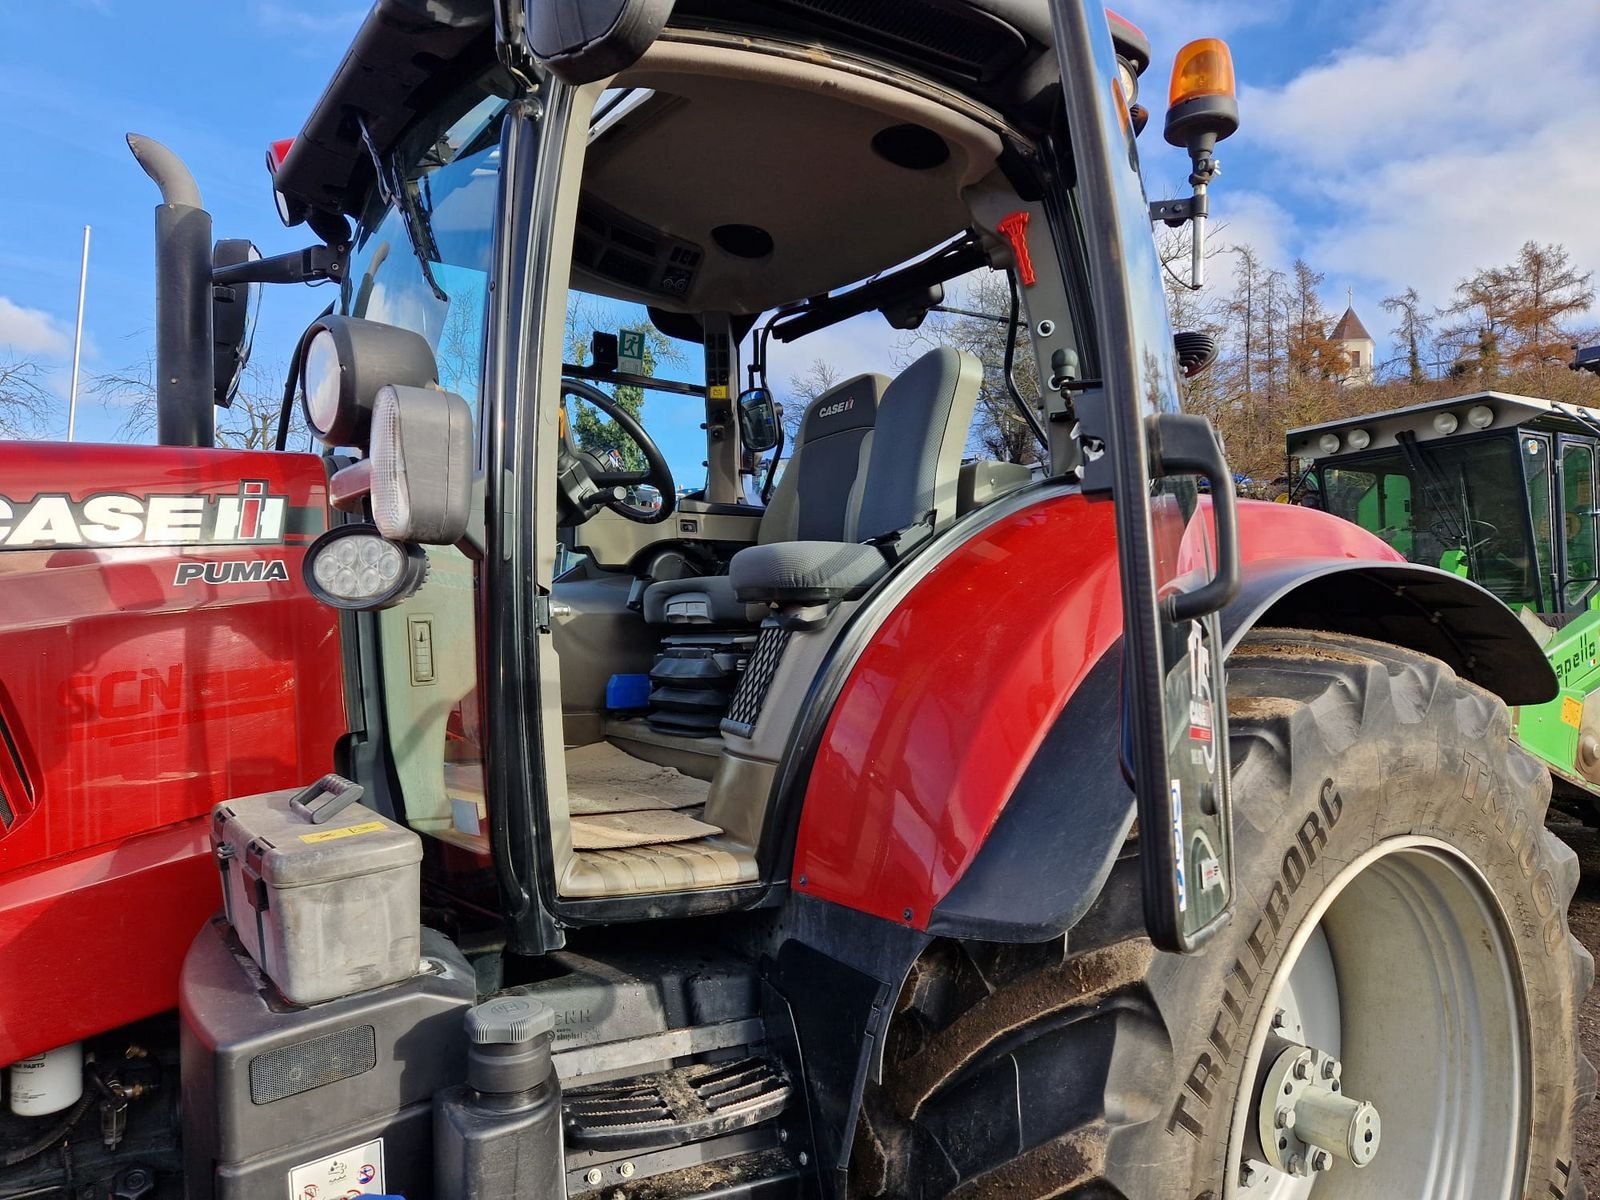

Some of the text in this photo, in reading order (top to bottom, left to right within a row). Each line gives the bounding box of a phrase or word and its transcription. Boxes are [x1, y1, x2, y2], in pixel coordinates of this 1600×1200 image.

[819, 402, 845, 418] CASE
[0, 495, 205, 546] ASE
[172, 560, 289, 586] PUMA
[1165, 776, 1344, 1144] TRELLEBORG
